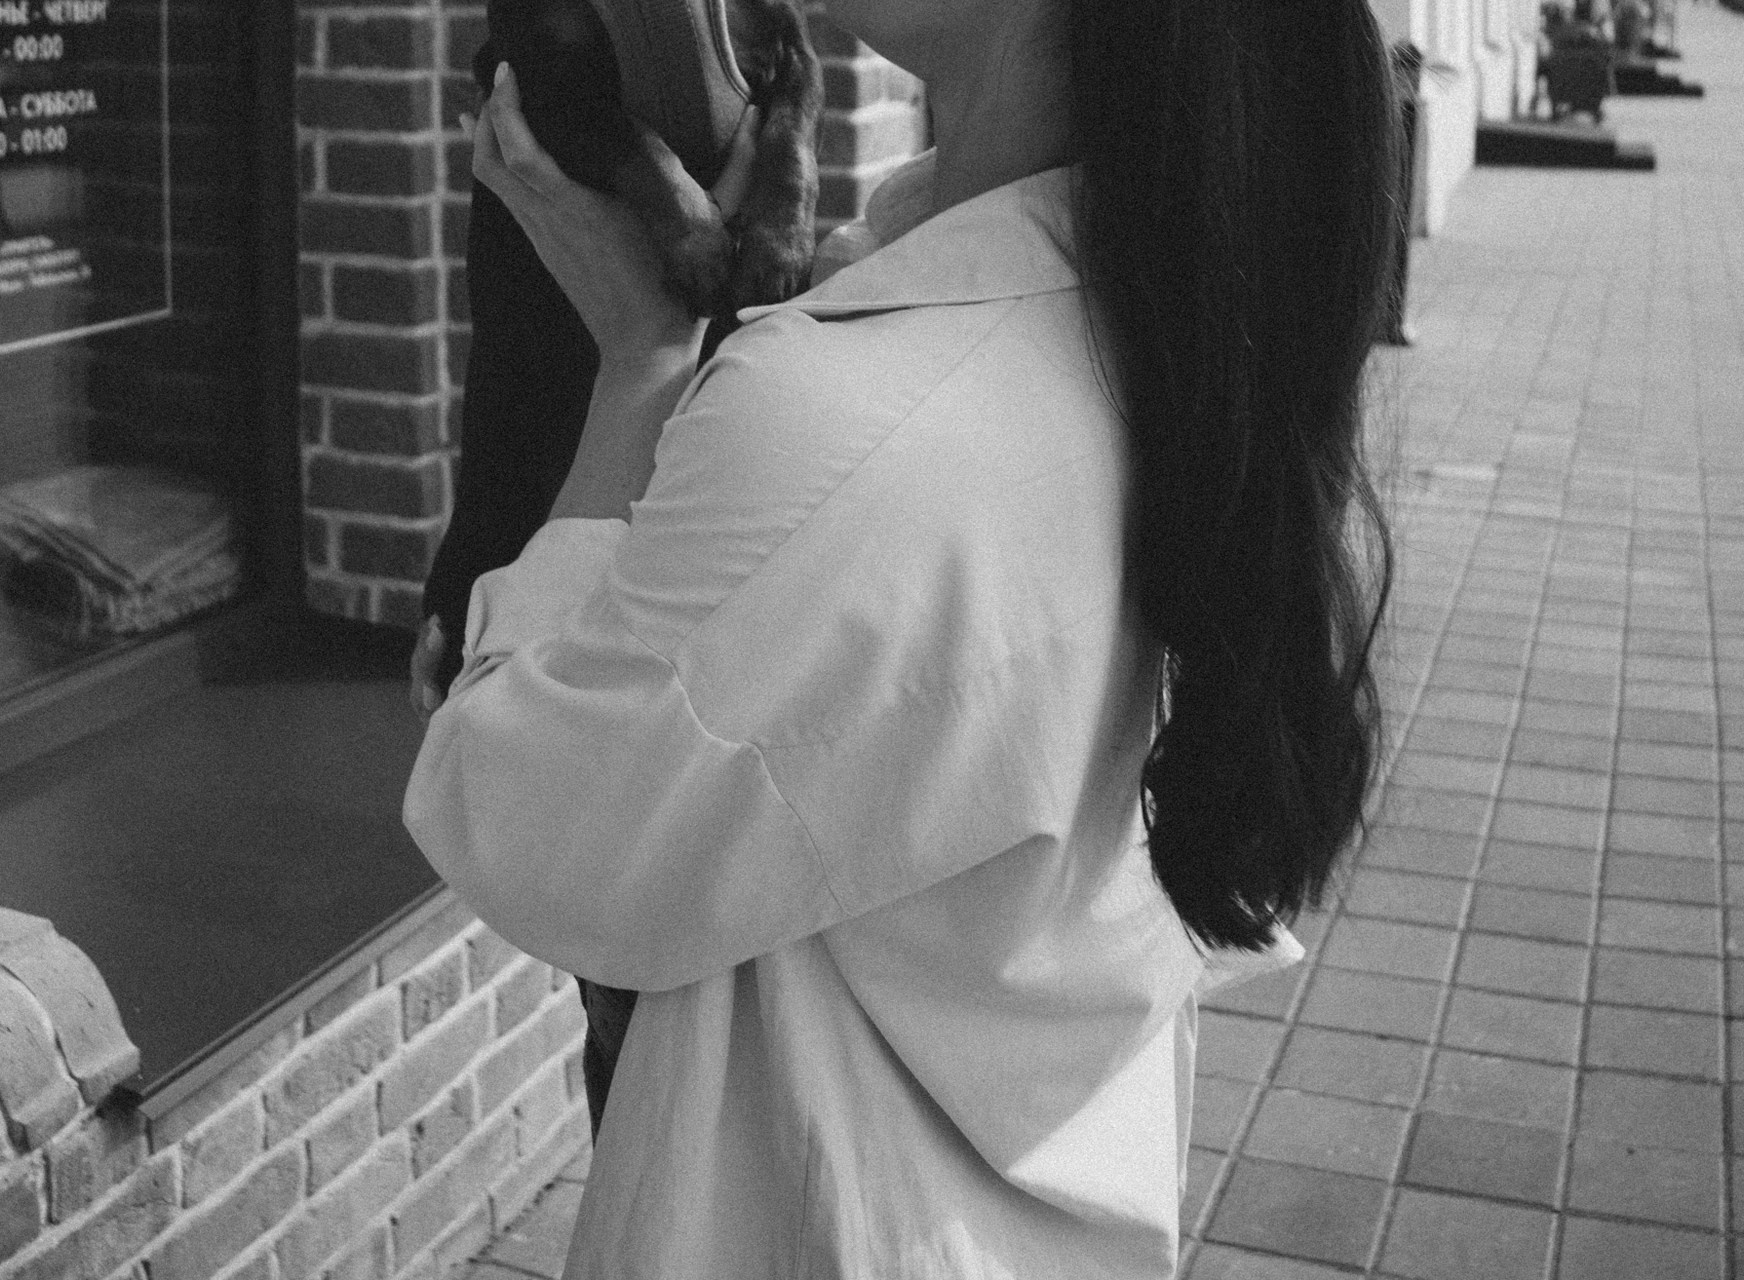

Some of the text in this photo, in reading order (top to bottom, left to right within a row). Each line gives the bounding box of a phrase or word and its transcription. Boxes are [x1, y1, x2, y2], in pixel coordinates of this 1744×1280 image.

[13, 34, 63, 62] 00:00
[20, 89, 97, 119] СУББОТА
[20, 125, 68, 154] 01:00
